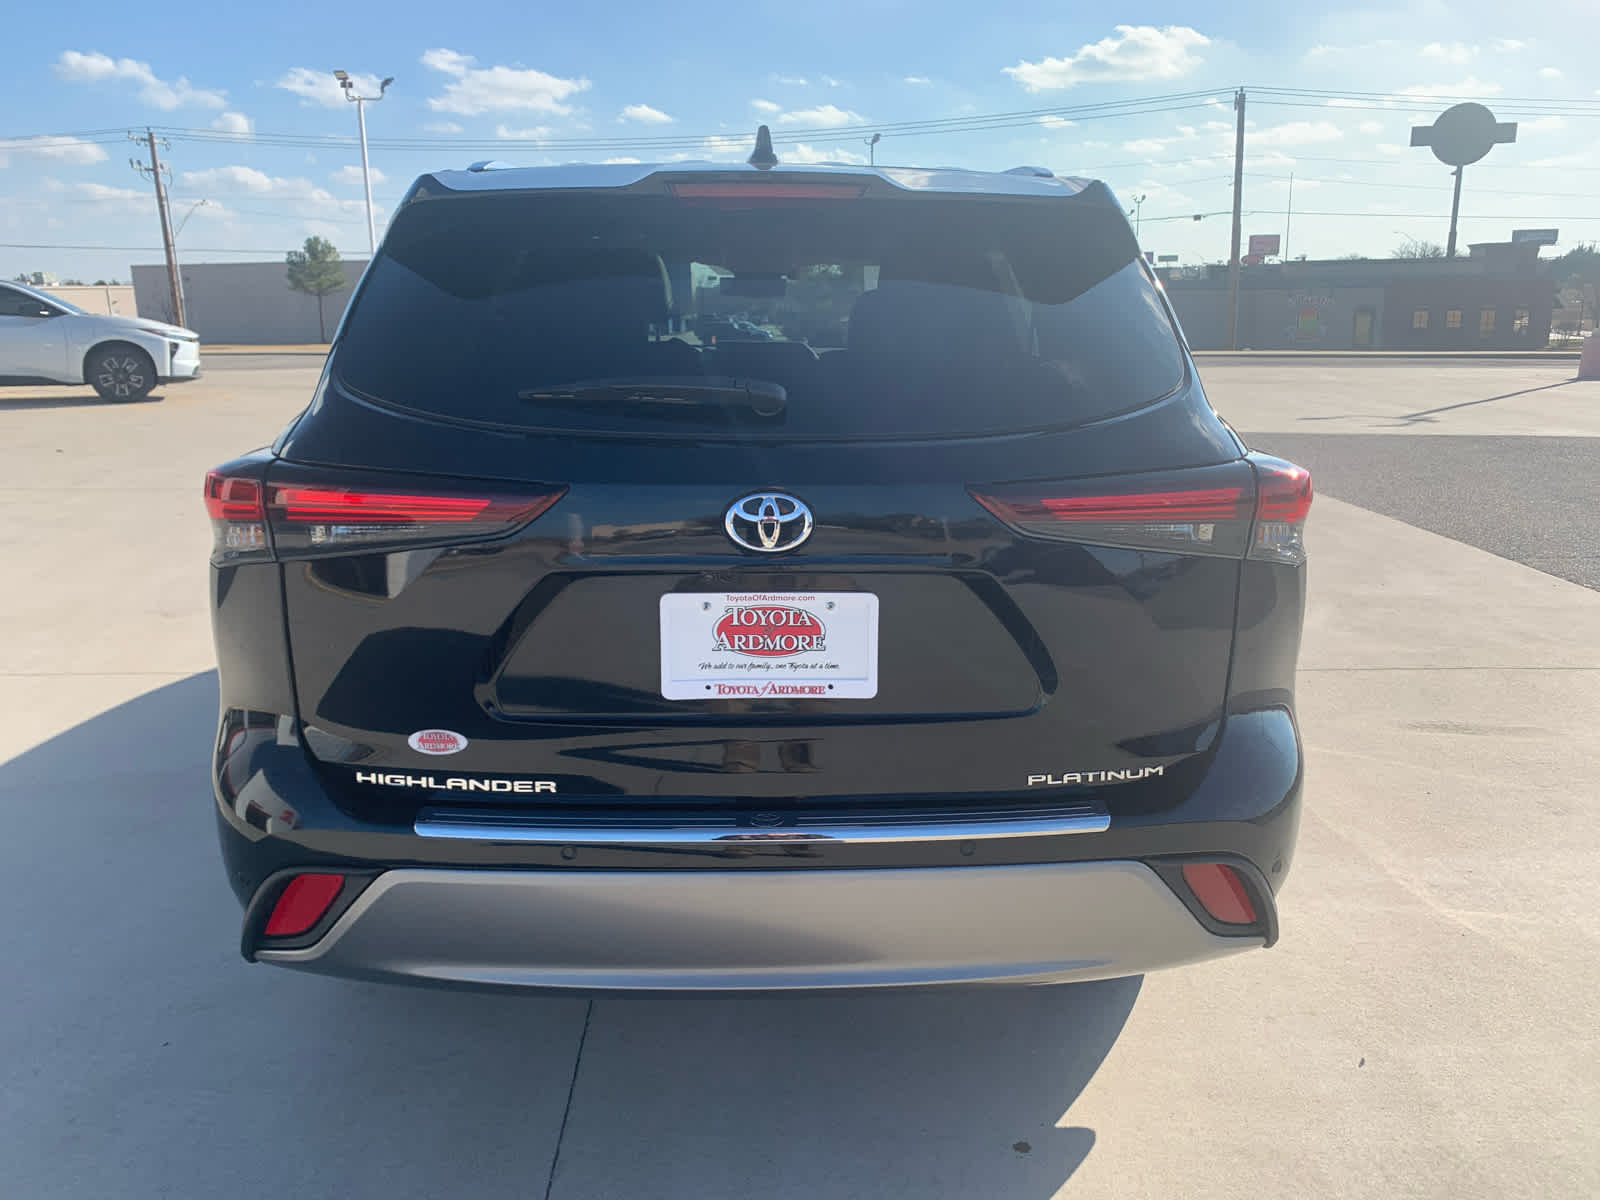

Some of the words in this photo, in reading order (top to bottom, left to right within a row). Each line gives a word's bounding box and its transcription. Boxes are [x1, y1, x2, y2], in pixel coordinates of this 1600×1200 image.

[726, 594, 816, 603] ToyotaOfArdmore.com
[725, 606, 814, 627] TOYOTA
[711, 631, 826, 652] ARDMORE
[714, 683, 759, 695] TOYOTA
[769, 683, 826, 695] ARDMORE
[355, 772, 558, 794] HIGHLANDER
[1027, 765, 1165, 786] PLATINUM
